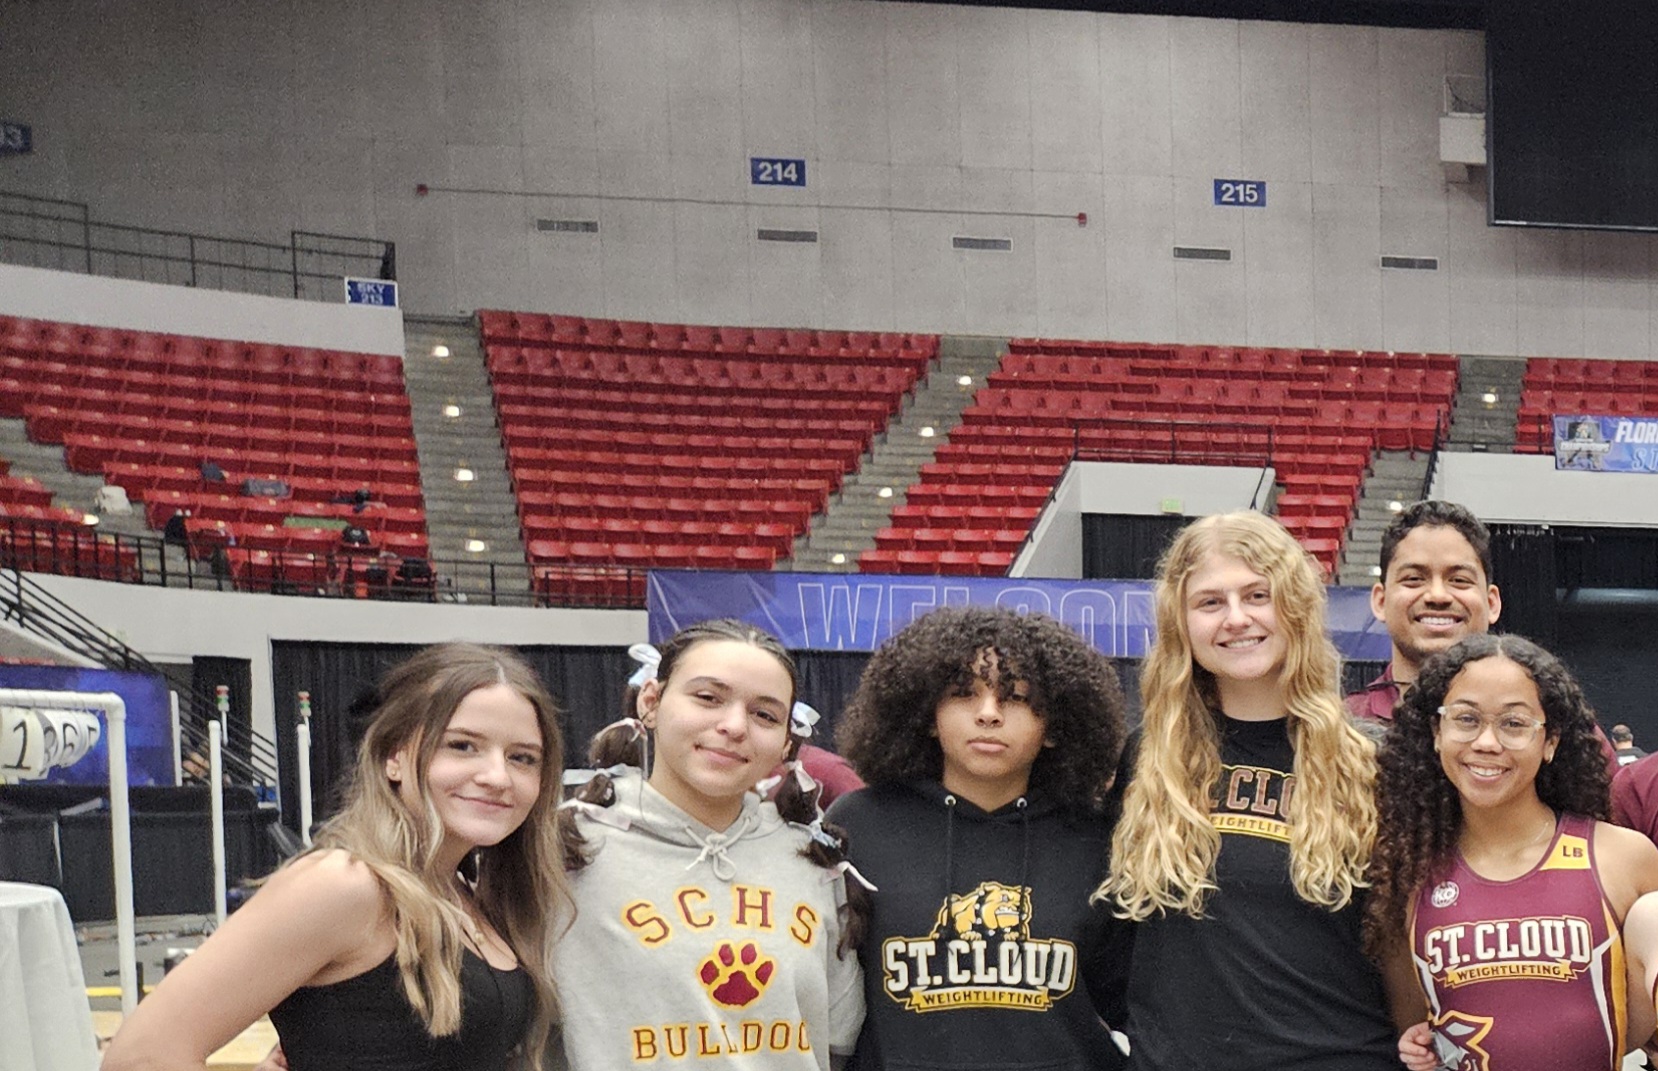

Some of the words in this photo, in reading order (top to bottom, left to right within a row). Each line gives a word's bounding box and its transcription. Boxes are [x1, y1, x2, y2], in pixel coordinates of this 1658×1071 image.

[758, 161, 798, 182] 214
[1221, 182, 1259, 203] 215
[1210, 817, 1292, 836] EIGHTLIFT
[1562, 845, 1585, 858] LB
[622, 883, 819, 946] SCHS
[1457, 964, 1562, 982] WEIGHTLIFTING
[922, 990, 1043, 1006] WEIGHTLIFTING
